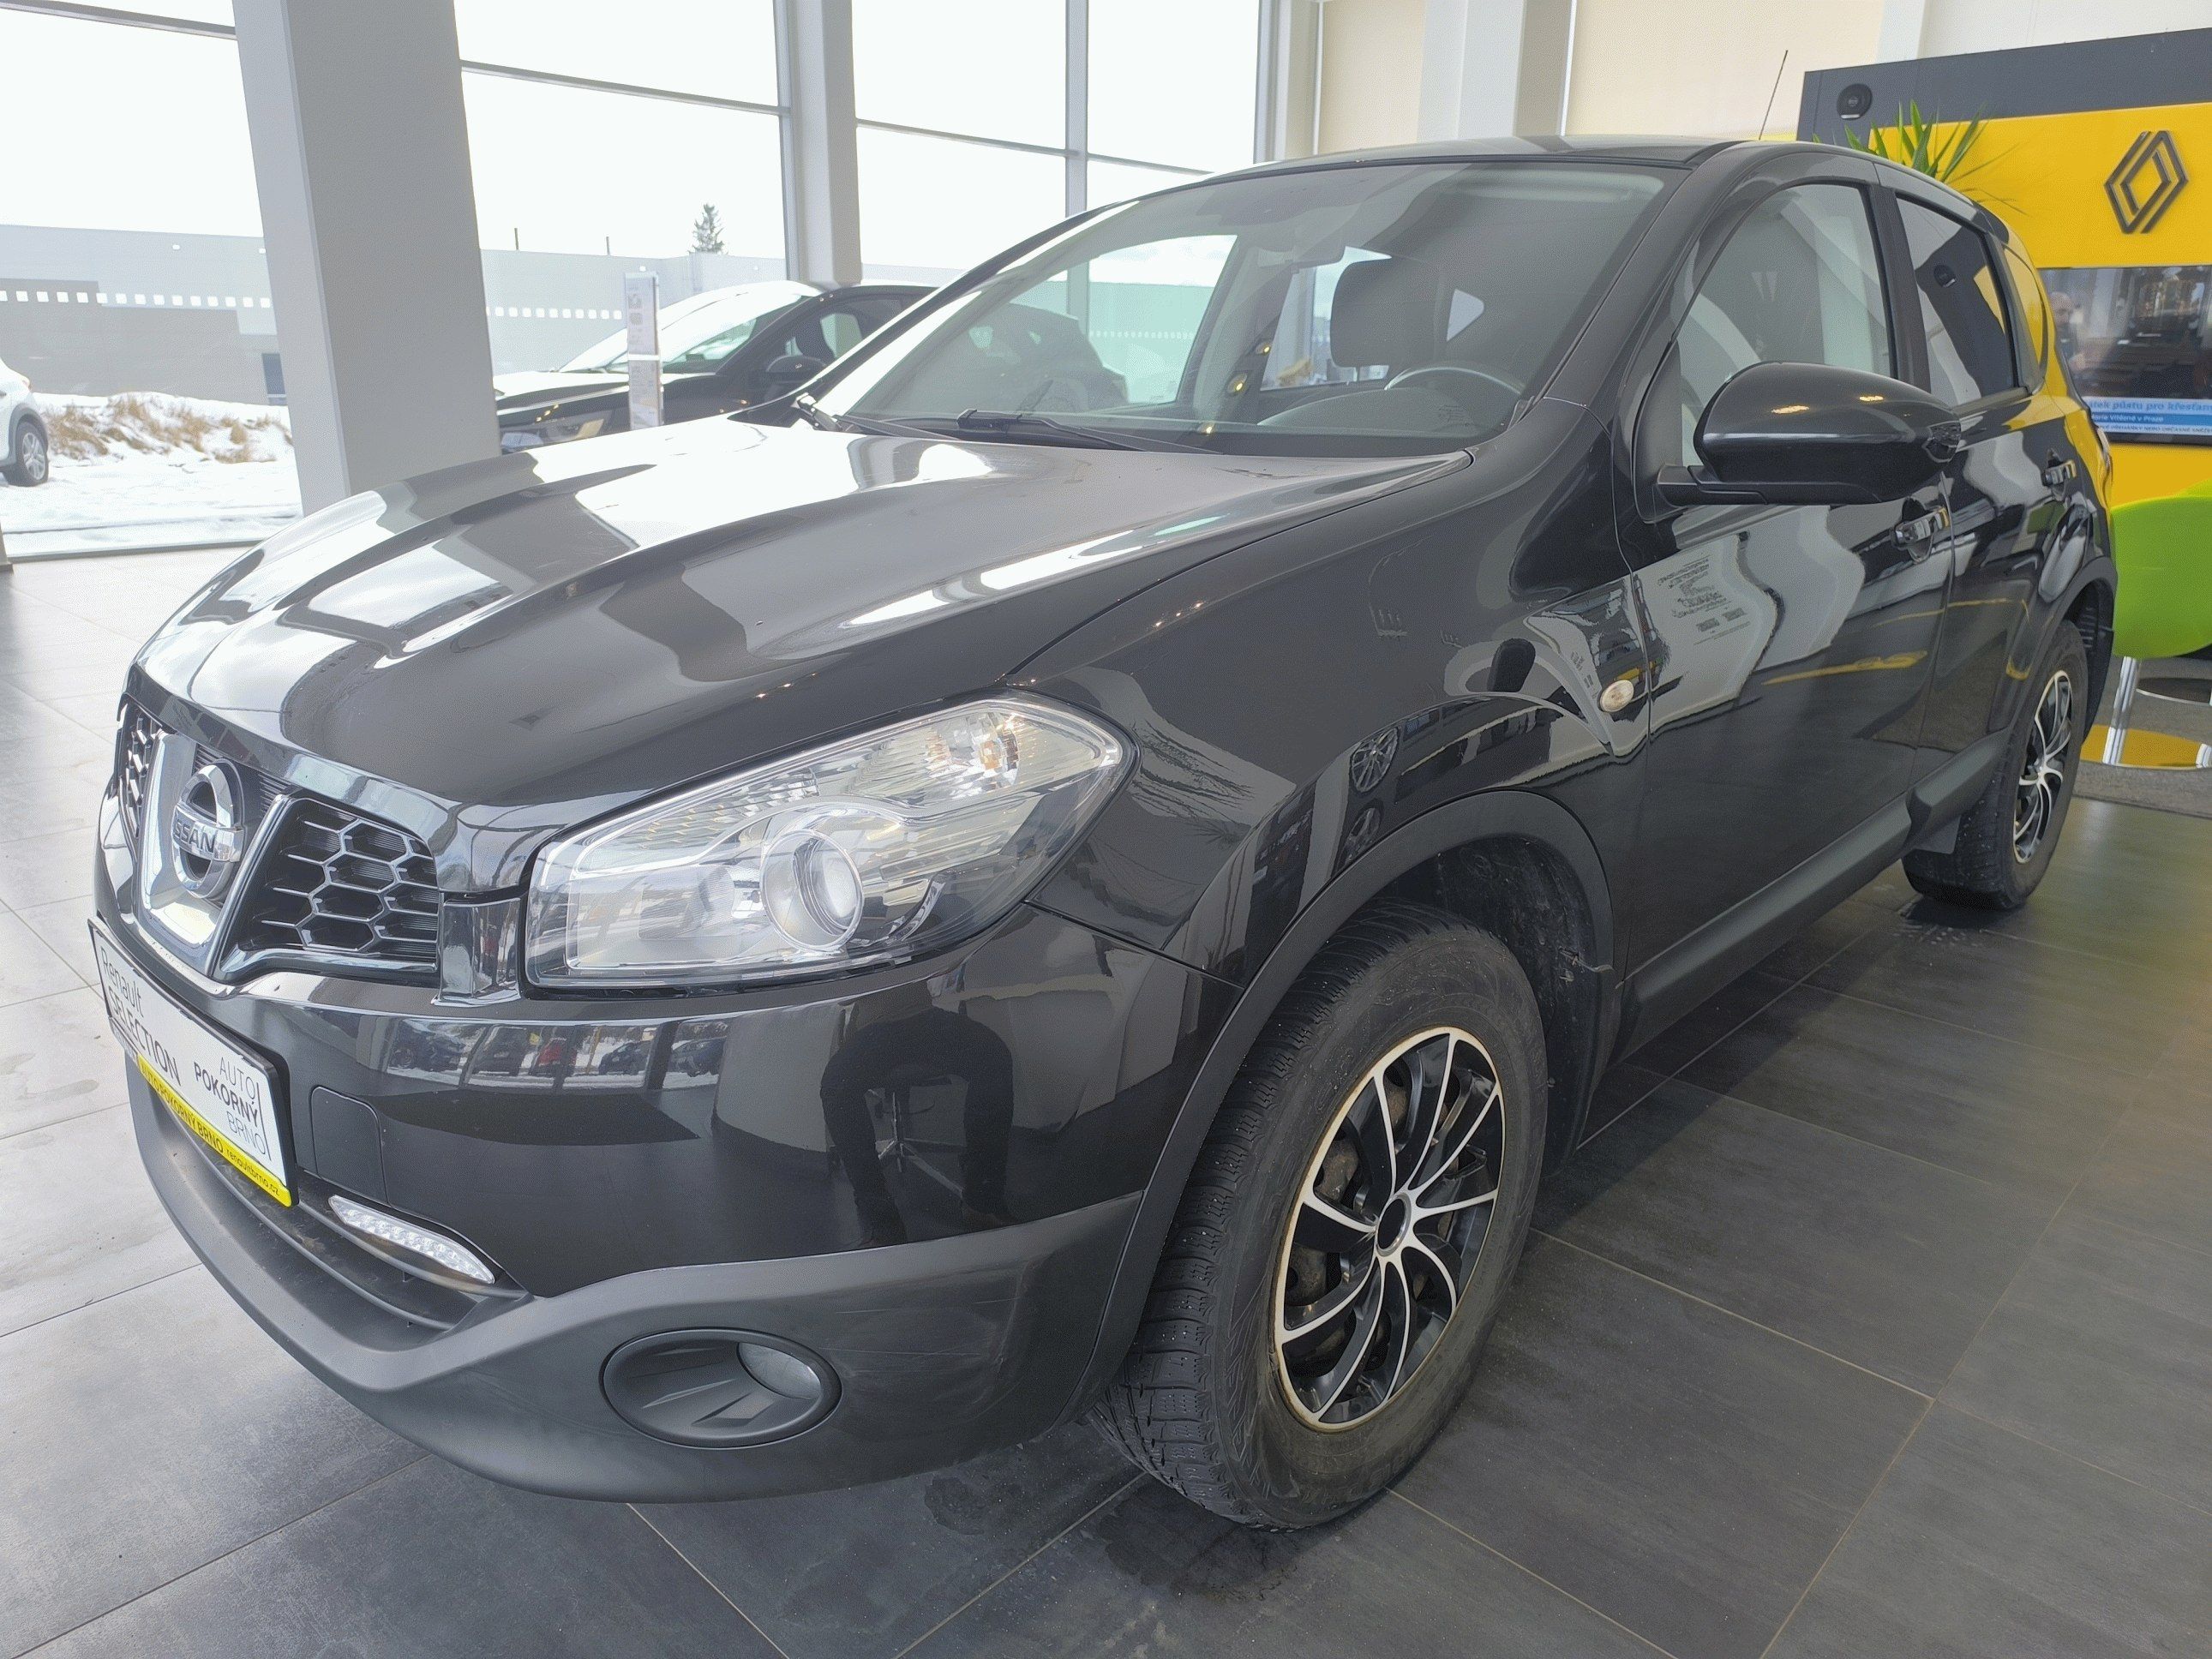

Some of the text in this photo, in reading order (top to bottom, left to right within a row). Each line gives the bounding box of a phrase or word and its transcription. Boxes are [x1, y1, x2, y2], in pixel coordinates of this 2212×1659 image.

[2146, 403, 2165, 411] pro
[2167, 401, 2212, 411] křesťan
[100, 946, 144, 1018] Renault
[109, 985, 182, 1087] SELECTION
[194, 1062, 258, 1128] POKORNÝ
[219, 1057, 255, 1099] AUTO
[141, 1064, 280, 1195] AUTO POKORNÝ BRNO renaultbrno.cz
[227, 1111, 266, 1155] BRNO
